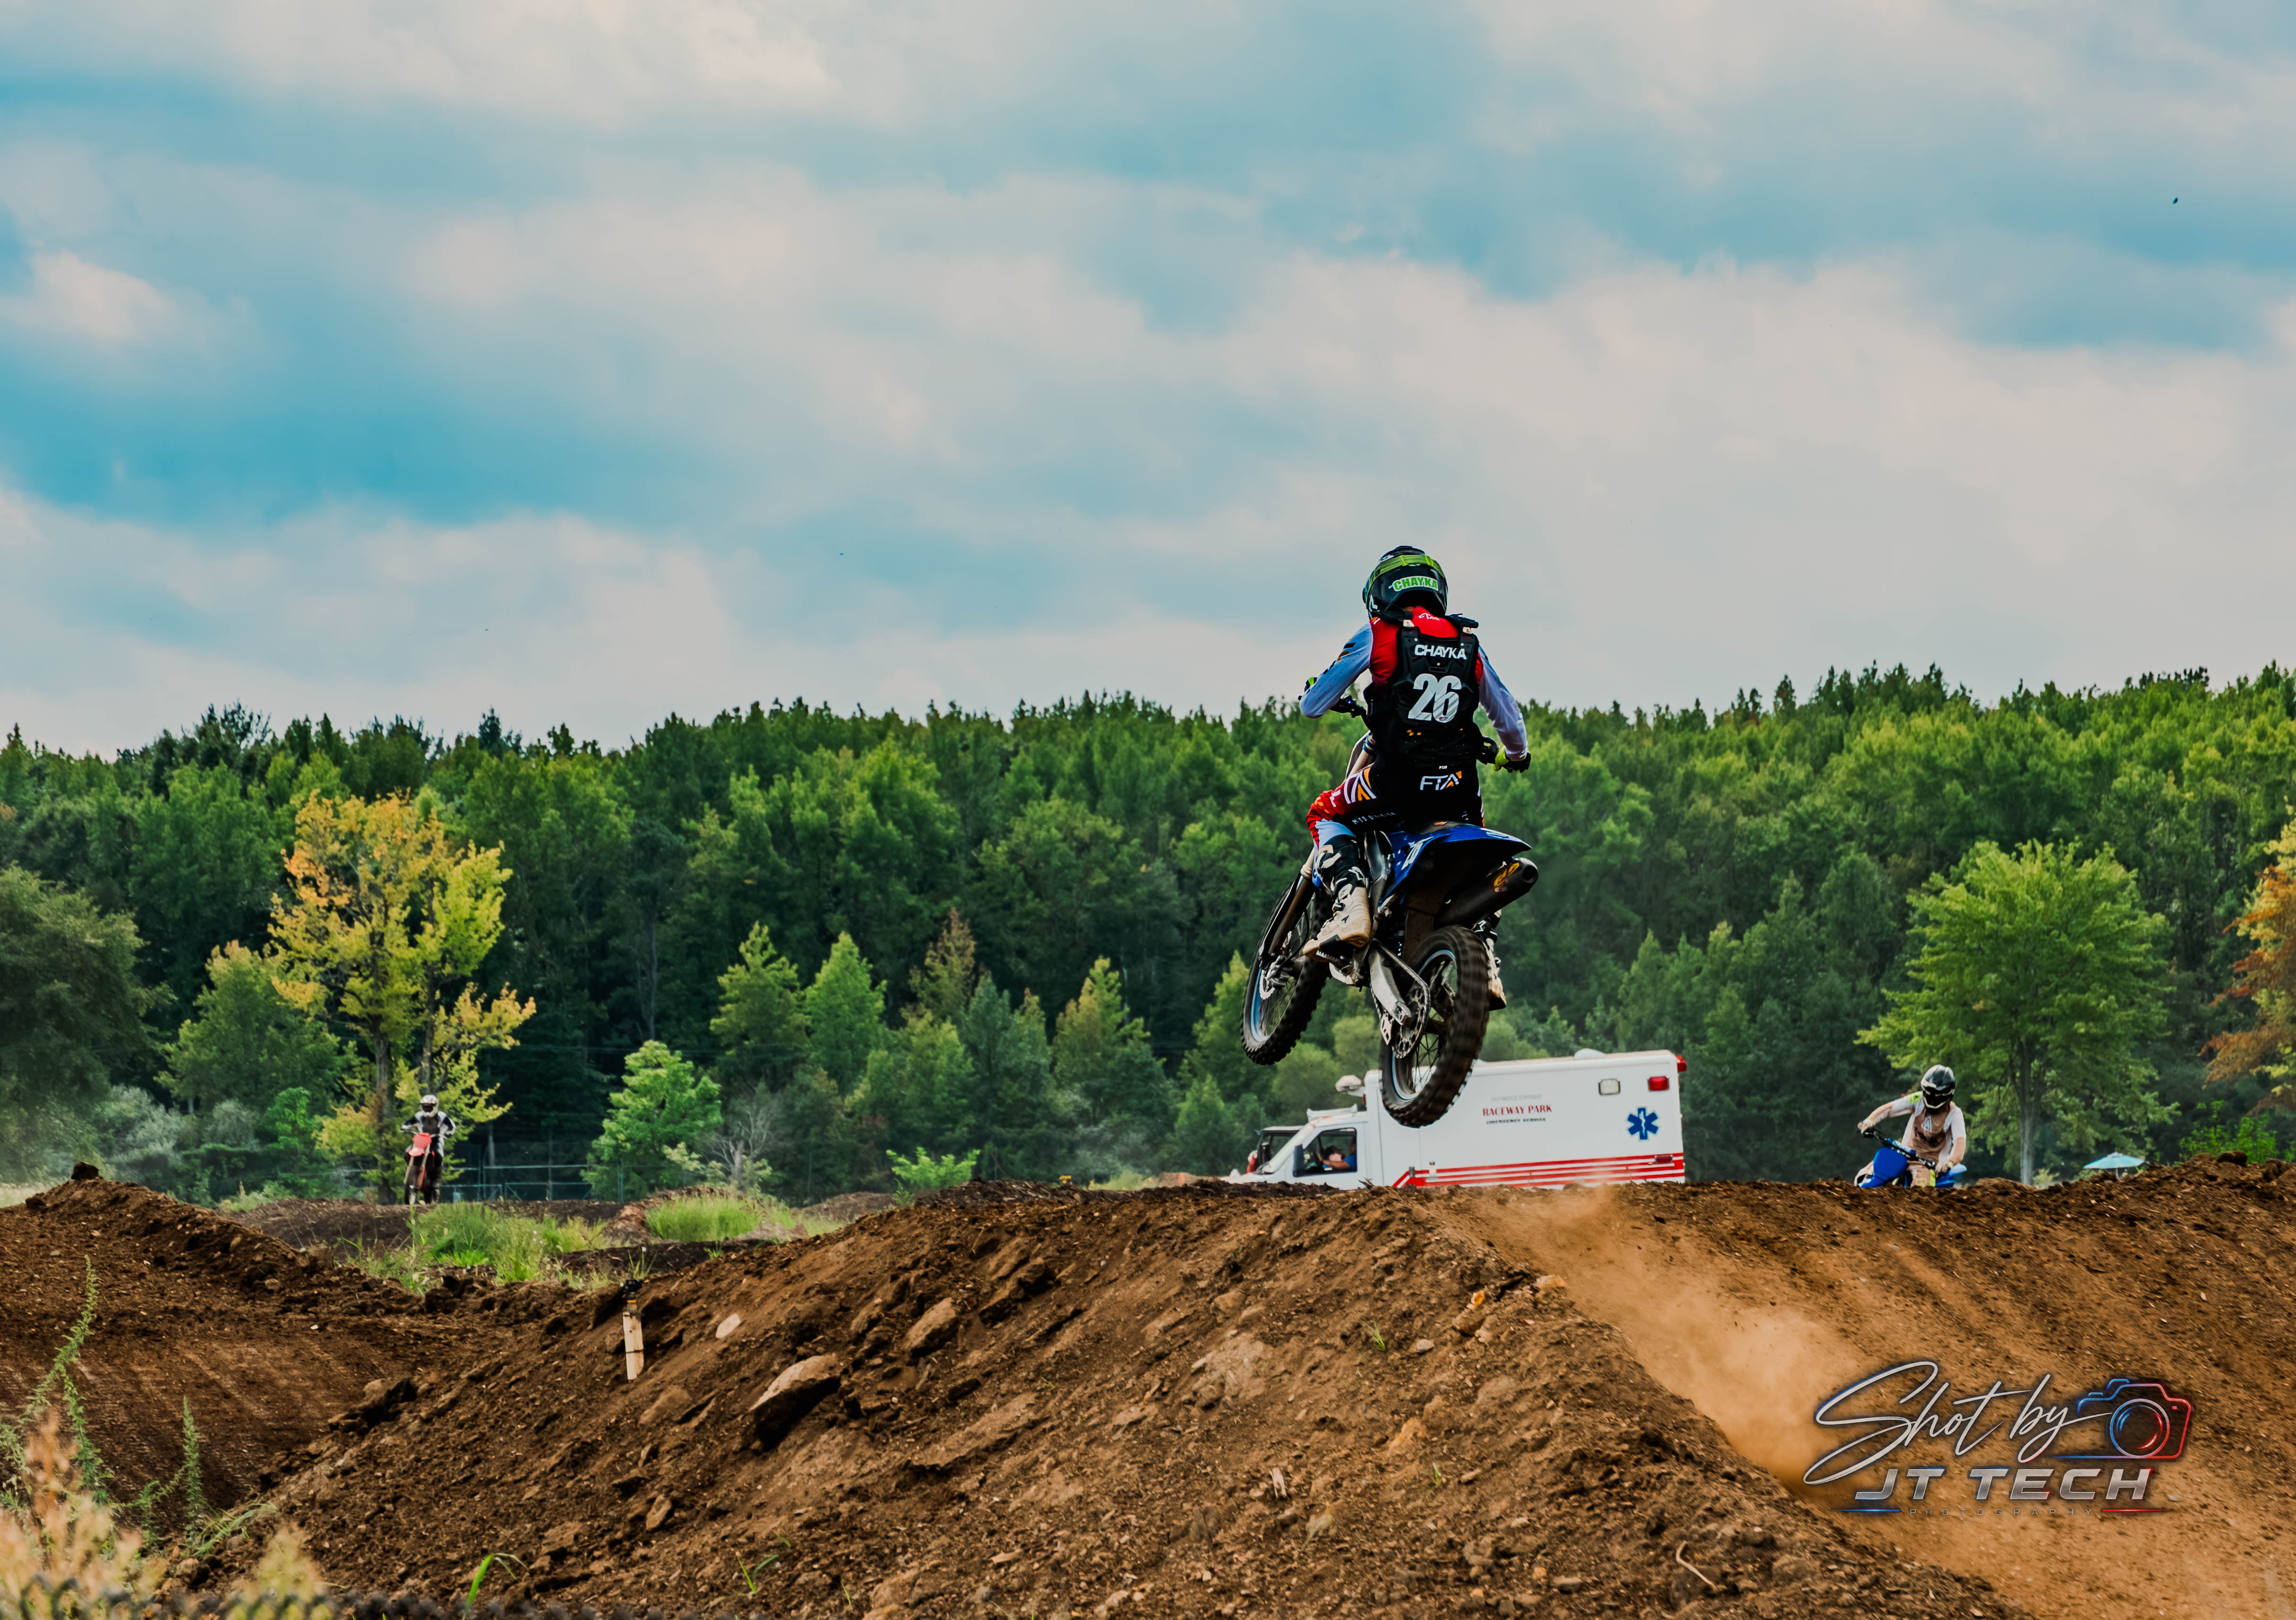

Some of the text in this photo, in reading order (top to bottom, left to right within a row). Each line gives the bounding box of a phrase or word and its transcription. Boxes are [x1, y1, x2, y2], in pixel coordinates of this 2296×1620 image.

[1393, 577, 1438, 591] CHAYKA
[1414, 644, 1467, 660] CHAYKA
[1408, 673, 1462, 723] 26
[1482, 1104, 1552, 1116] RACEWAY PARK
